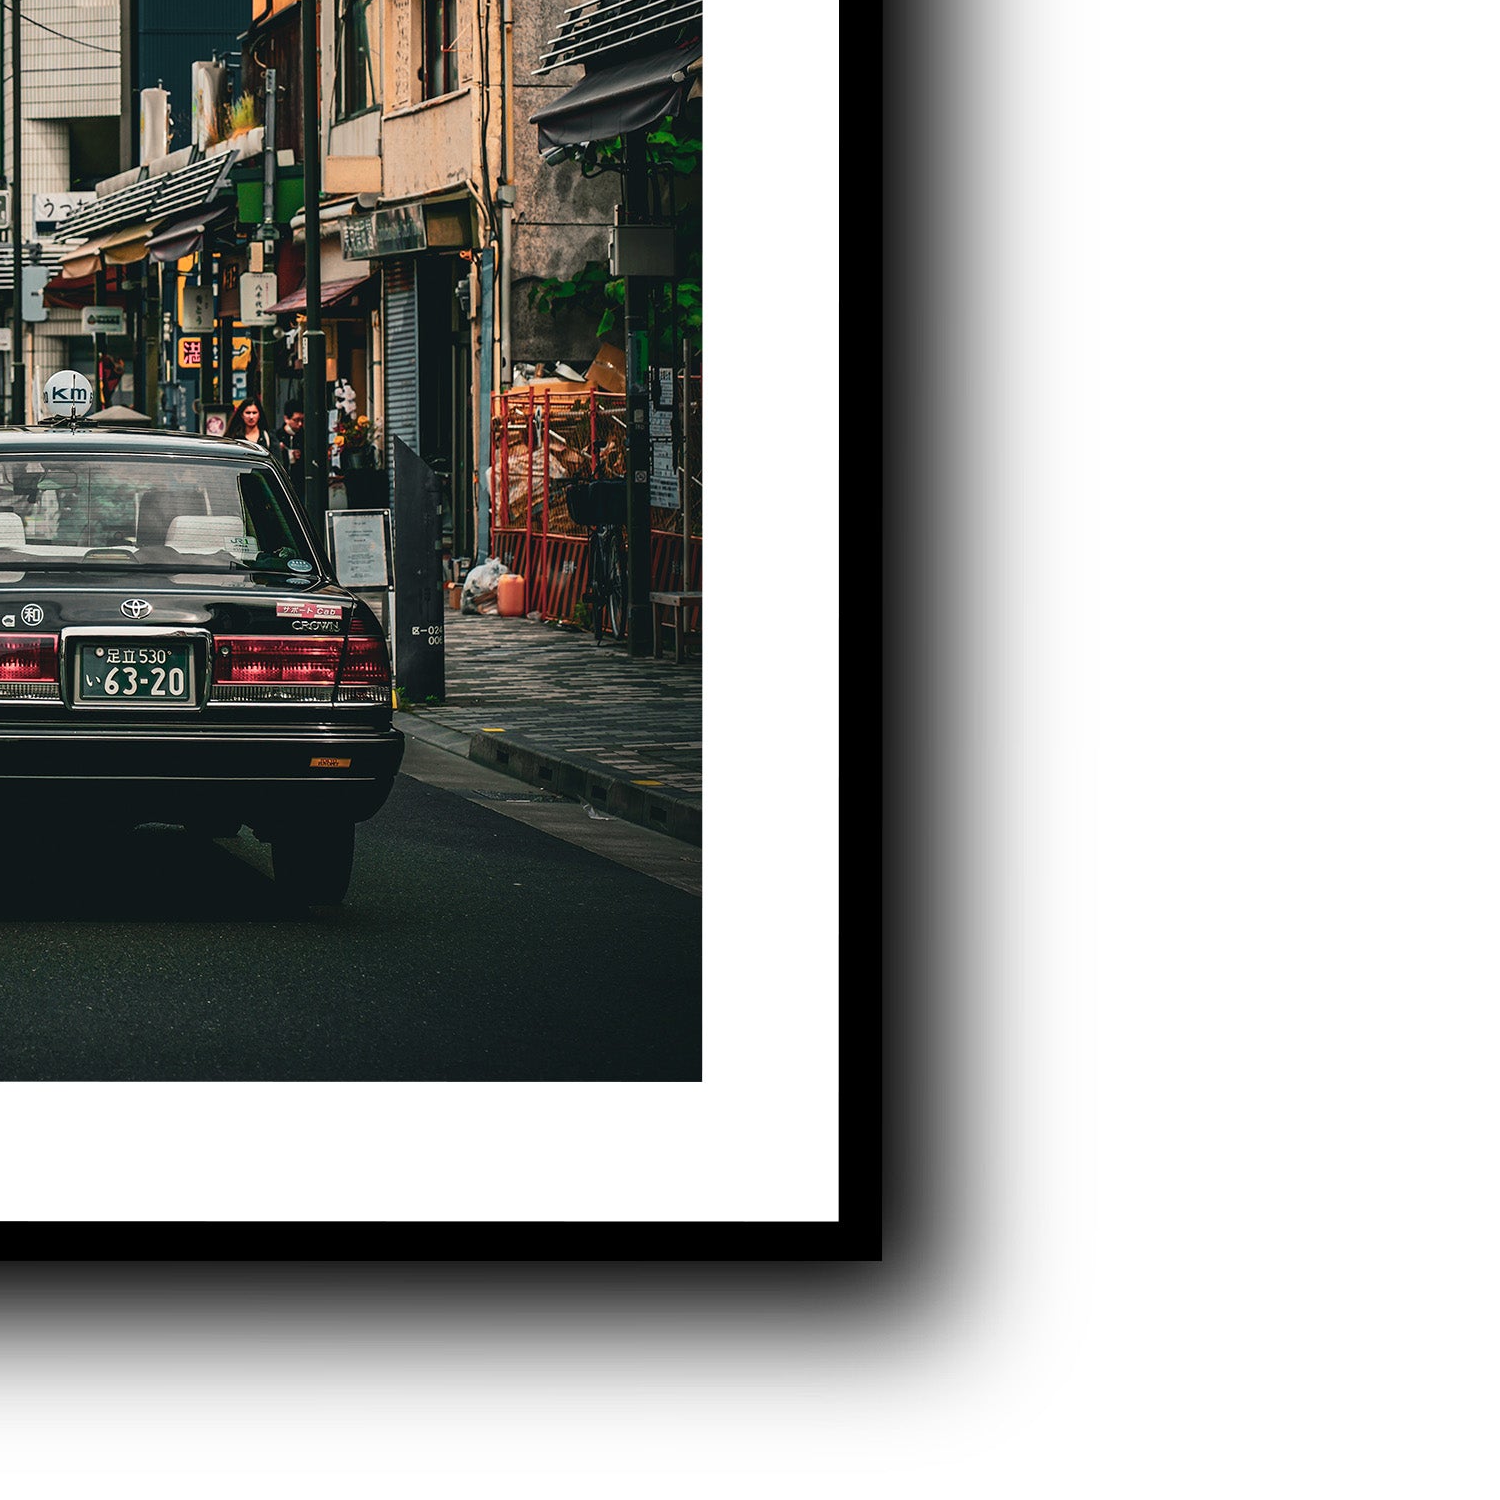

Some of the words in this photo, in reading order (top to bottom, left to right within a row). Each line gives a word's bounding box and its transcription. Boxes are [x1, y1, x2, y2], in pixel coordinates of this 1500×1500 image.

[22, 605, 43, 625] 和
[283, 605, 314, 615] サポート
[316, 607, 337, 616] Cab
[291, 620, 340, 633] CROWN
[106, 648, 137, 664] 足立
[139, 649, 166, 664] 530
[85, 674, 101, 687] い
[104, 666, 184, 696] 63-20
